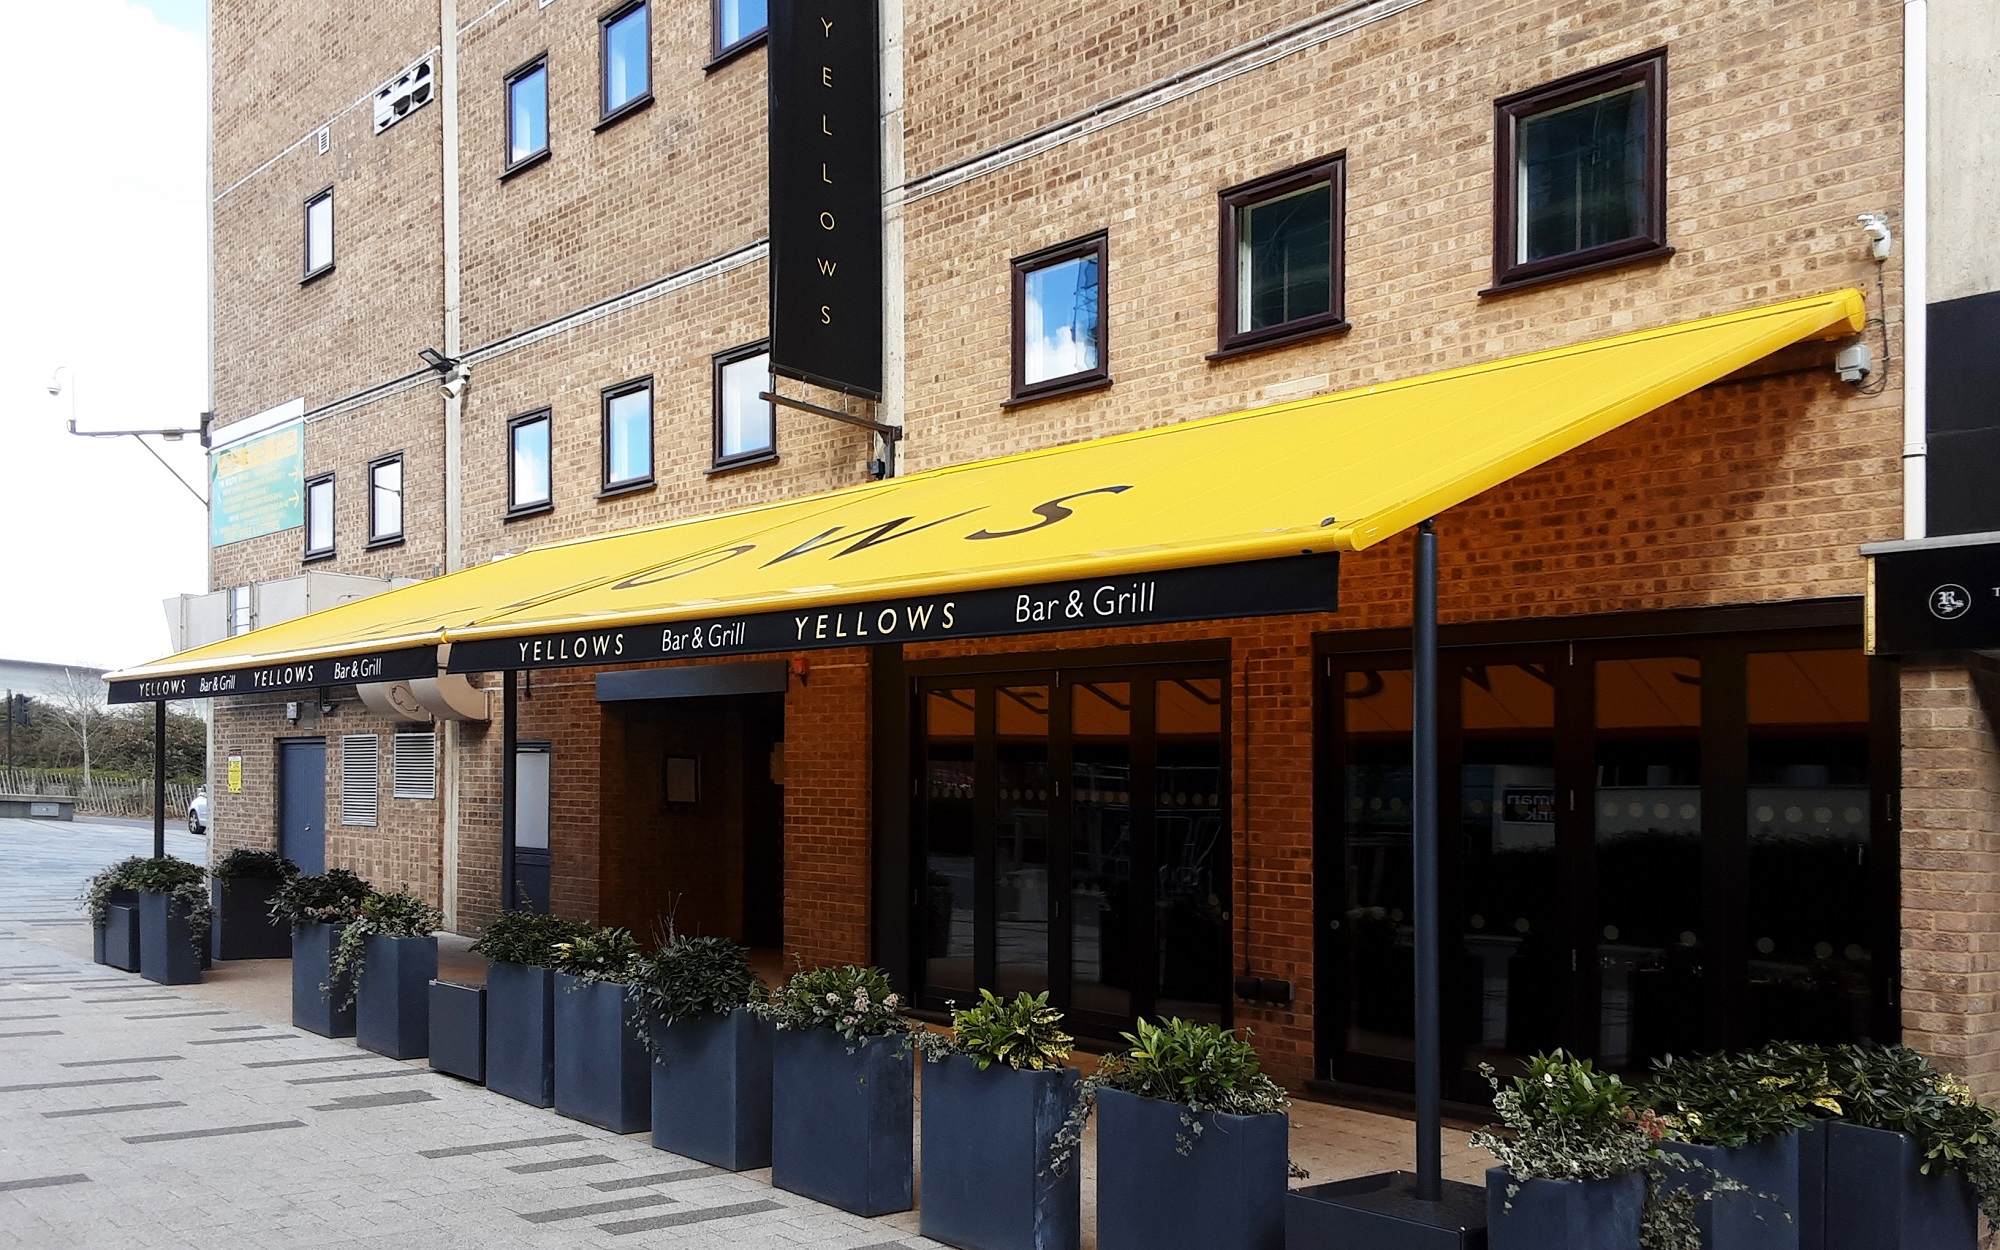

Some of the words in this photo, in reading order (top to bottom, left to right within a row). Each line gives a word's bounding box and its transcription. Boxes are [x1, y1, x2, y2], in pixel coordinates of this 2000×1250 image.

[818, 17, 837, 325] YELLOWS
[519, 633, 624, 662] YELLOWS
[661, 630, 690, 653] Bar
[708, 621, 746, 649] Grill
[794, 602, 955, 641] YELLOWS
[1015, 594, 1061, 623] Bar
[1092, 581, 1155, 616] Grill
[139, 679, 186, 697] YELLOWS
[254, 664, 314, 688] YELLOWS
[360, 657, 382, 677] Grill
